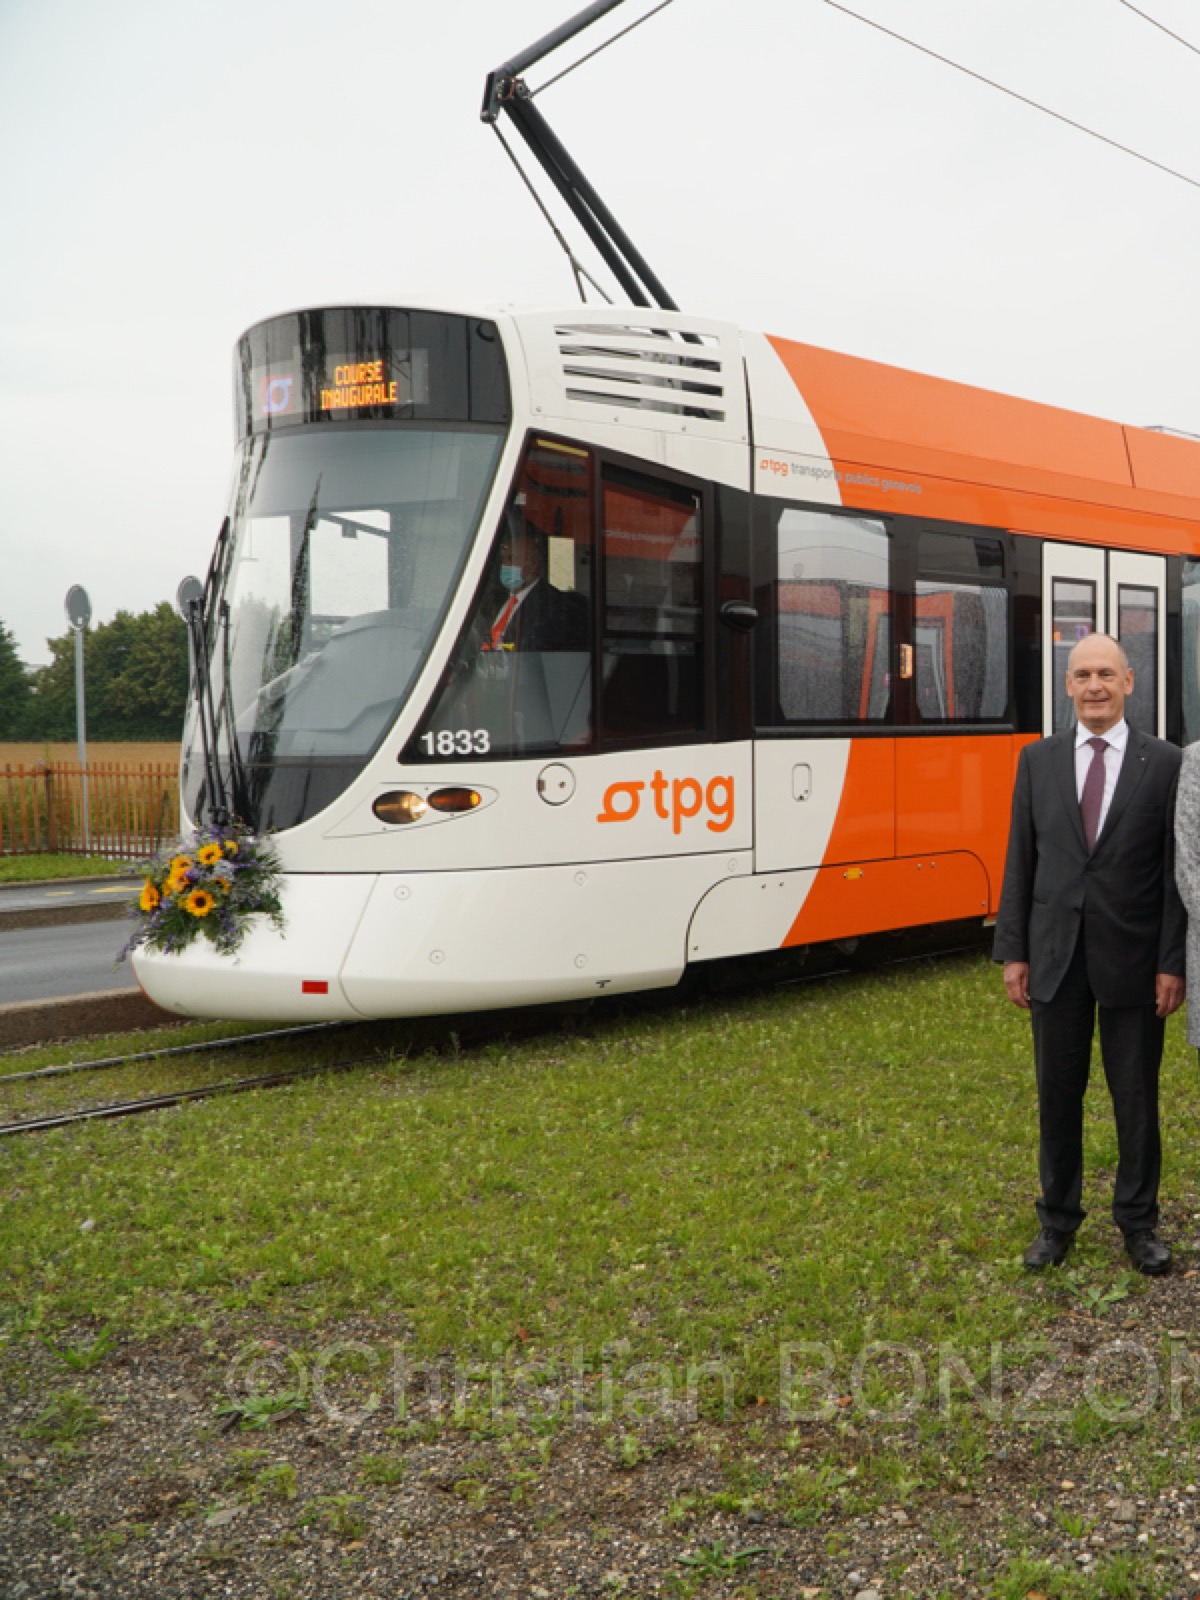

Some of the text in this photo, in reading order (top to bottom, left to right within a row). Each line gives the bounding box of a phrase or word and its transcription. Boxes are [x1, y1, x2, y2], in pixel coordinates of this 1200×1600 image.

[334, 360, 385, 386] COURSE
[320, 381, 399, 411] INAUGURALE
[791, 462, 843, 481] transports
[845, 471, 880, 487] publics
[421, 729, 490, 755] 1833
